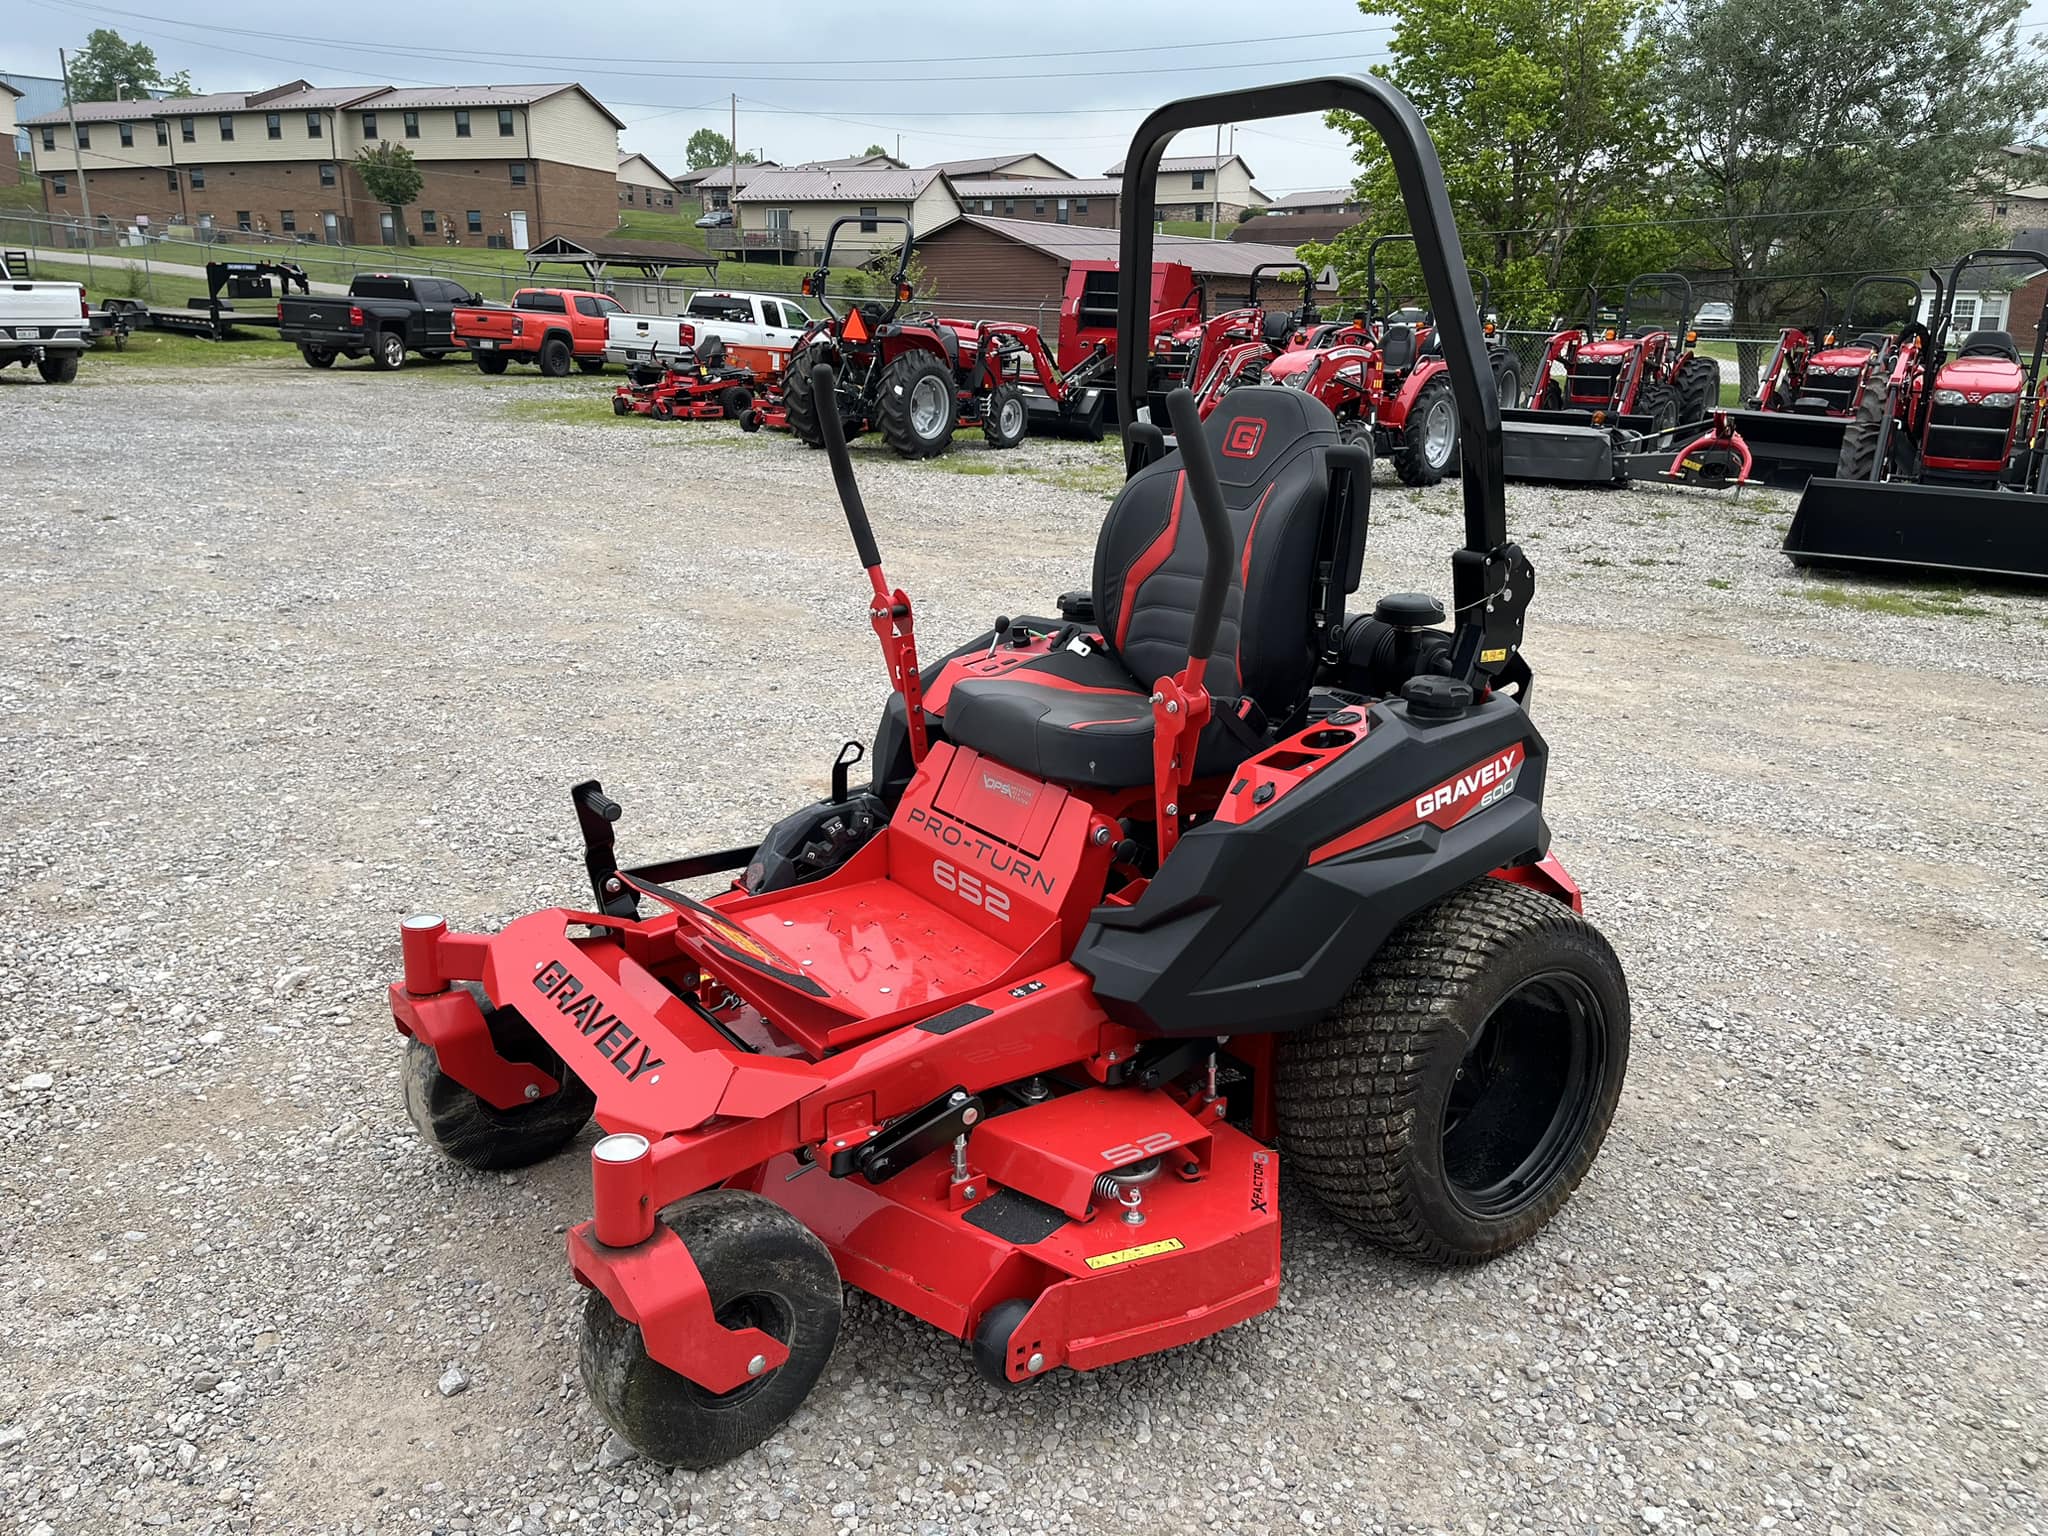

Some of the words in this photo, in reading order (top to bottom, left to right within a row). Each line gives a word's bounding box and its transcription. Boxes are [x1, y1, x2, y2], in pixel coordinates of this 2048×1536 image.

[1415, 750, 1515, 819] GRAVELY
[1480, 778, 1514, 807] 600
[907, 807, 1056, 895] PRO-TURN
[933, 859, 1011, 922] 652
[532, 959, 666, 1082] GRAVELY
[1100, 1132, 1181, 1165] 52
